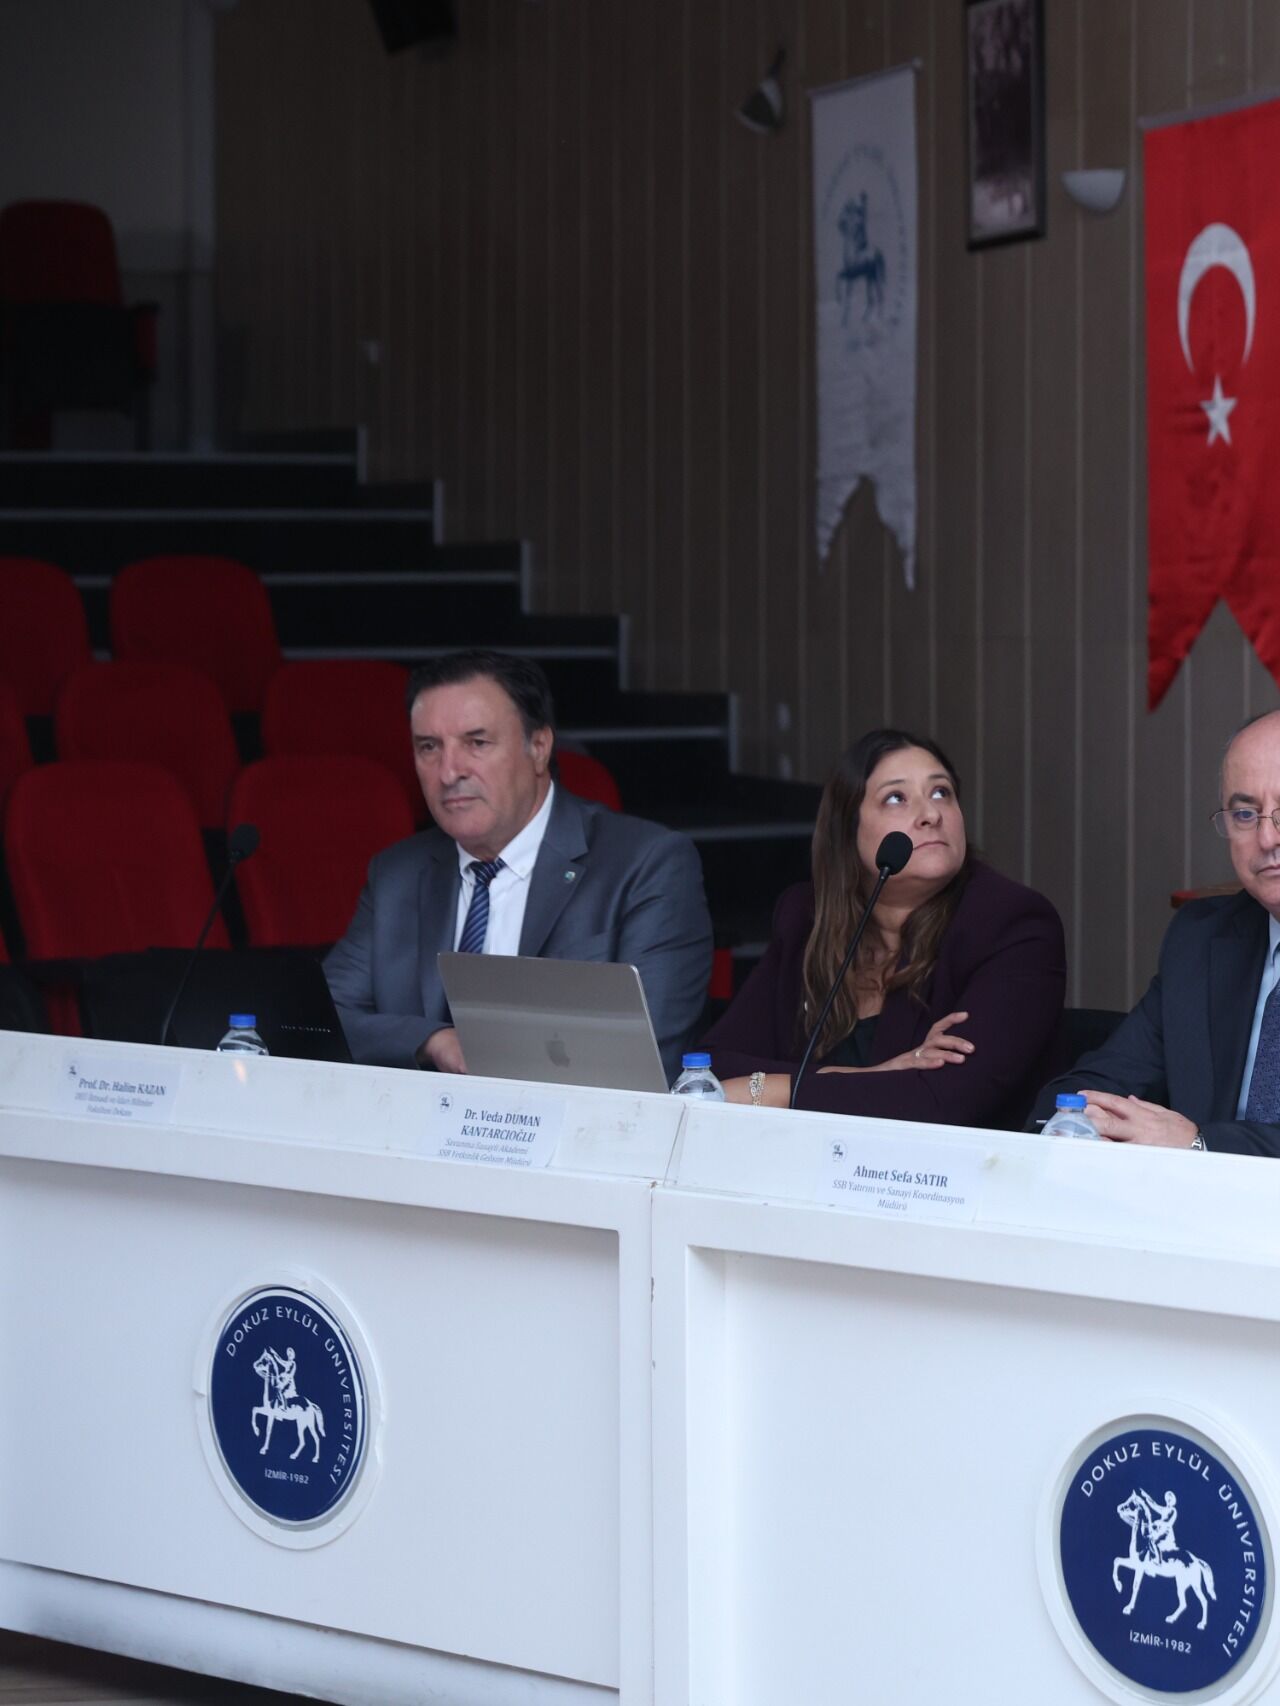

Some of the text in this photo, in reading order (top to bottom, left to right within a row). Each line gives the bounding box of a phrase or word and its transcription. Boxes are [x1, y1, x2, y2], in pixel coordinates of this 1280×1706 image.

[79, 1078, 166, 1096] Prof. Dr. Halim KAZAN
[464, 1108, 541, 1127] Dr. Veda DUMAN
[461, 1125, 536, 1143] KANTARCIOĞLU
[853, 1165, 949, 1188] Ahmet Sefa SATIR
[832, 1179, 847, 1190] SSB
[848, 1181, 875, 1195] Yatırım
[876, 1187, 885, 1196] ve
[912, 1190, 965, 1206] Koordinasyon
[226, 1307, 270, 1358] DOKUZ
[276, 1305, 319, 1336] EYLÜL
[1081, 1442, 1141, 1498] DOKUZ
[1152, 1441, 1211, 1481] EYLÜL
[1129, 1629, 1192, 1654] İZMİR-1982
